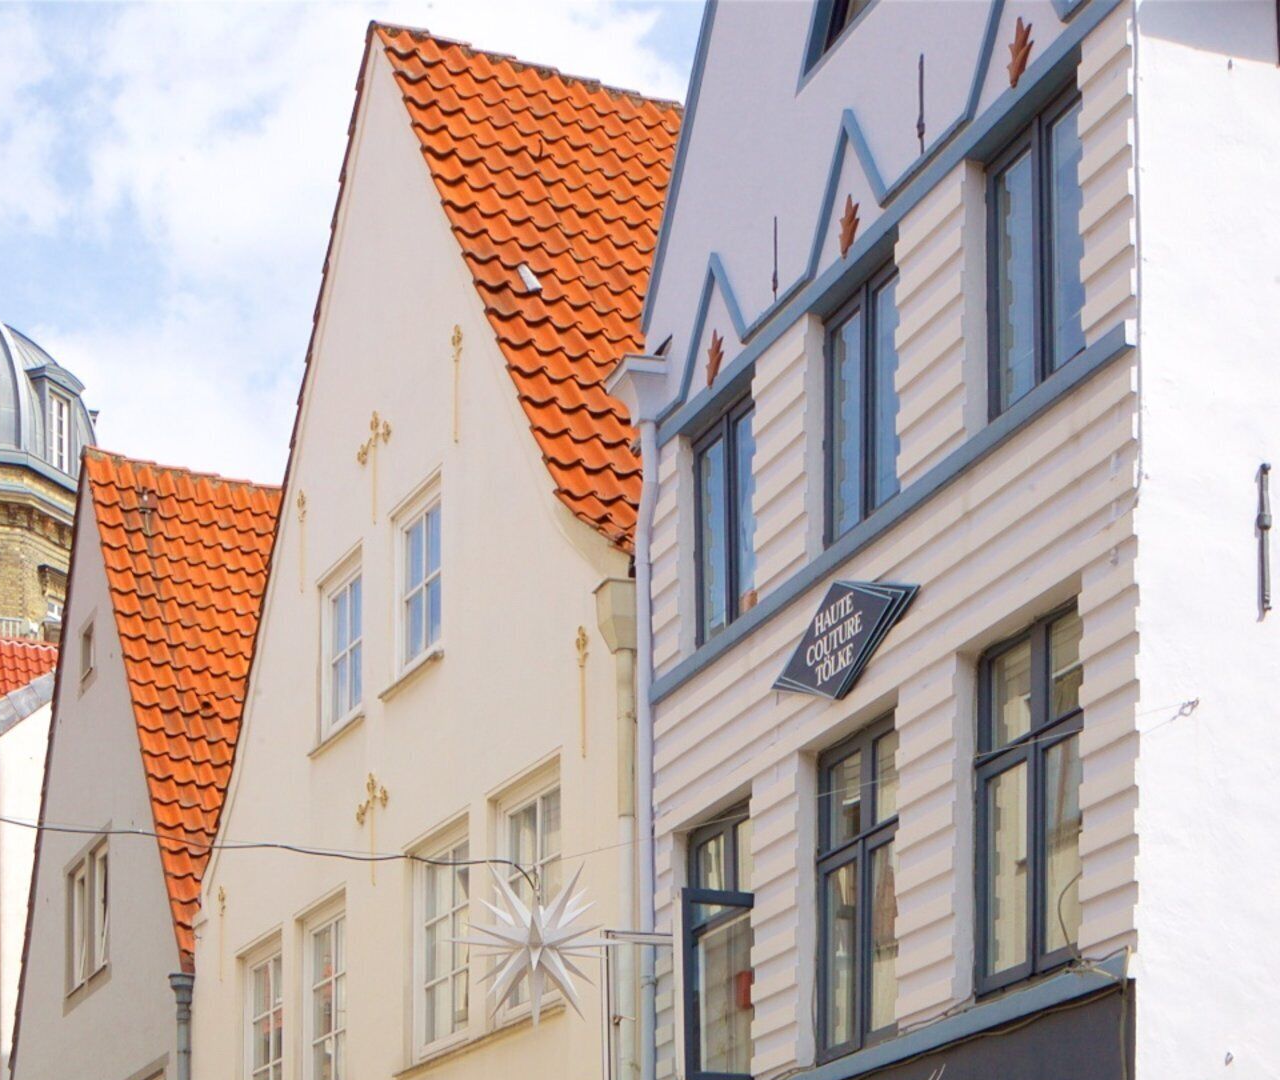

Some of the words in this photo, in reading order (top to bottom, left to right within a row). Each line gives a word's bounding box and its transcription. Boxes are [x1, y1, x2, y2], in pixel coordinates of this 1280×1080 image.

[814, 592, 854, 638] HAUTE
[806, 611, 863, 667] COUTURE
[814, 643, 854, 687] TÖLKE
